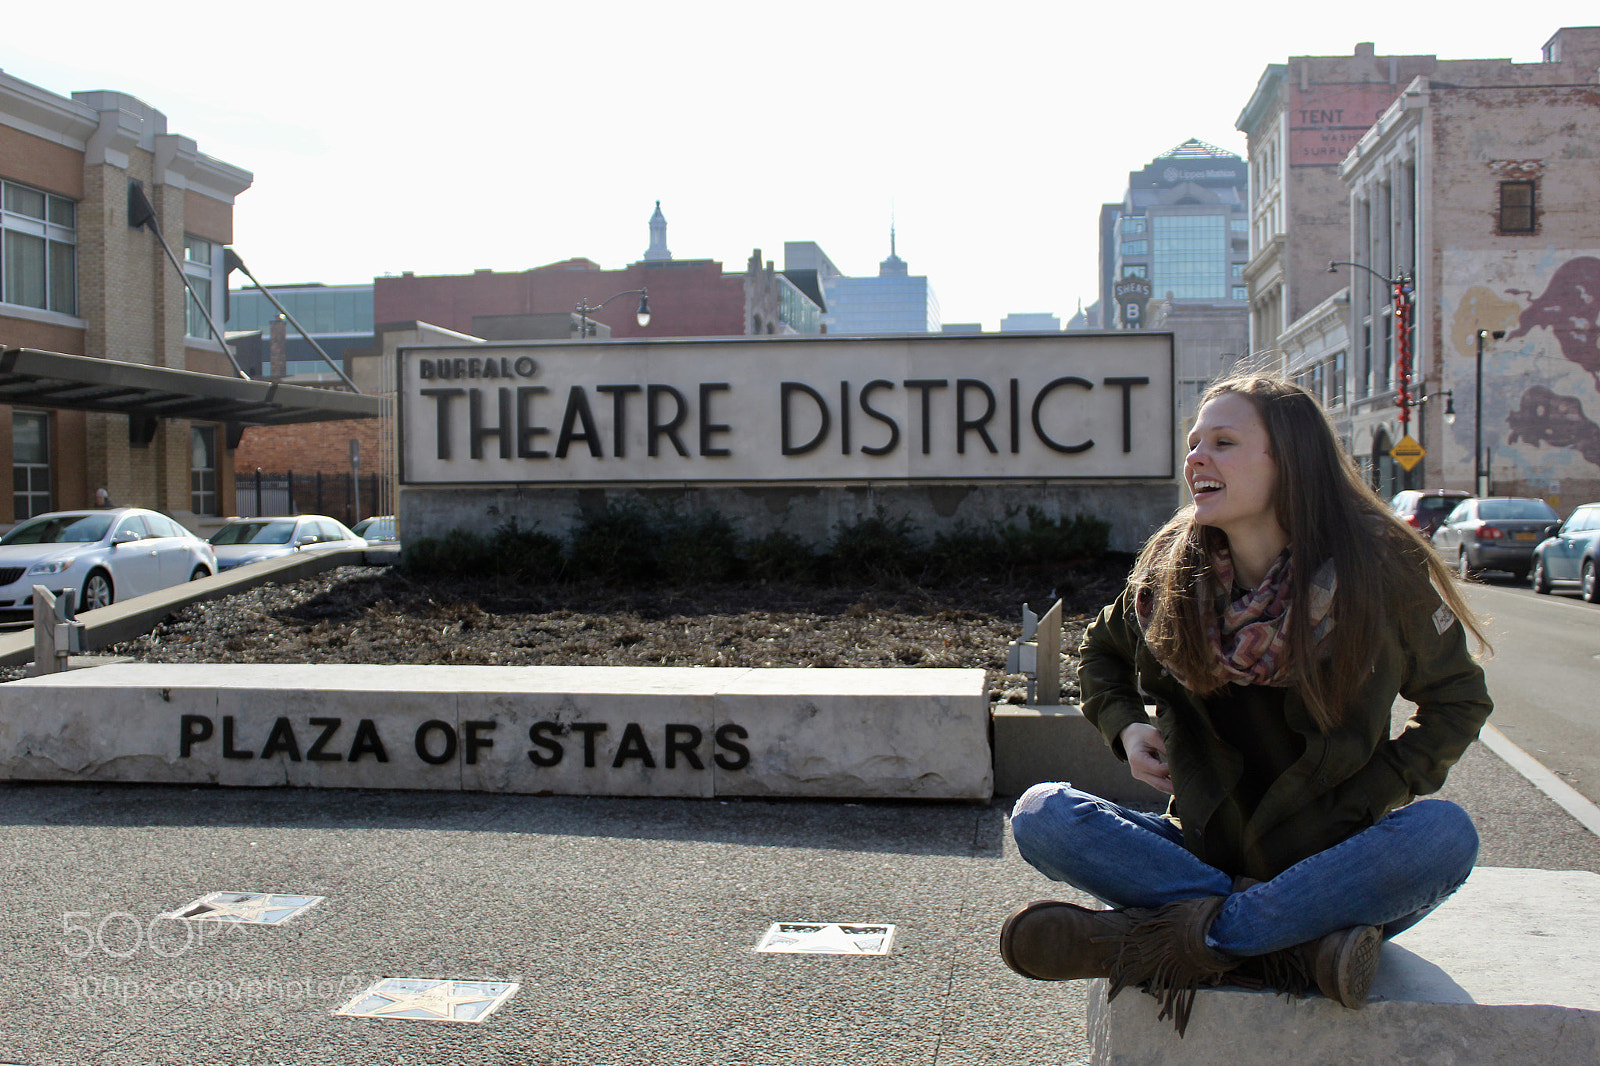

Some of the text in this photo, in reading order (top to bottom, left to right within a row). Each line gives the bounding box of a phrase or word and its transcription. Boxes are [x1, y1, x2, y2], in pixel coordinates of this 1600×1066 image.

[1299, 109, 1344, 123] TENT
[1304, 147, 1350, 156] SURPL
[420, 356, 537, 379] BUFFALO
[420, 376, 1149, 460] THEATRE DISTRICT
[179, 714, 751, 771] PLAZA OF STARS
